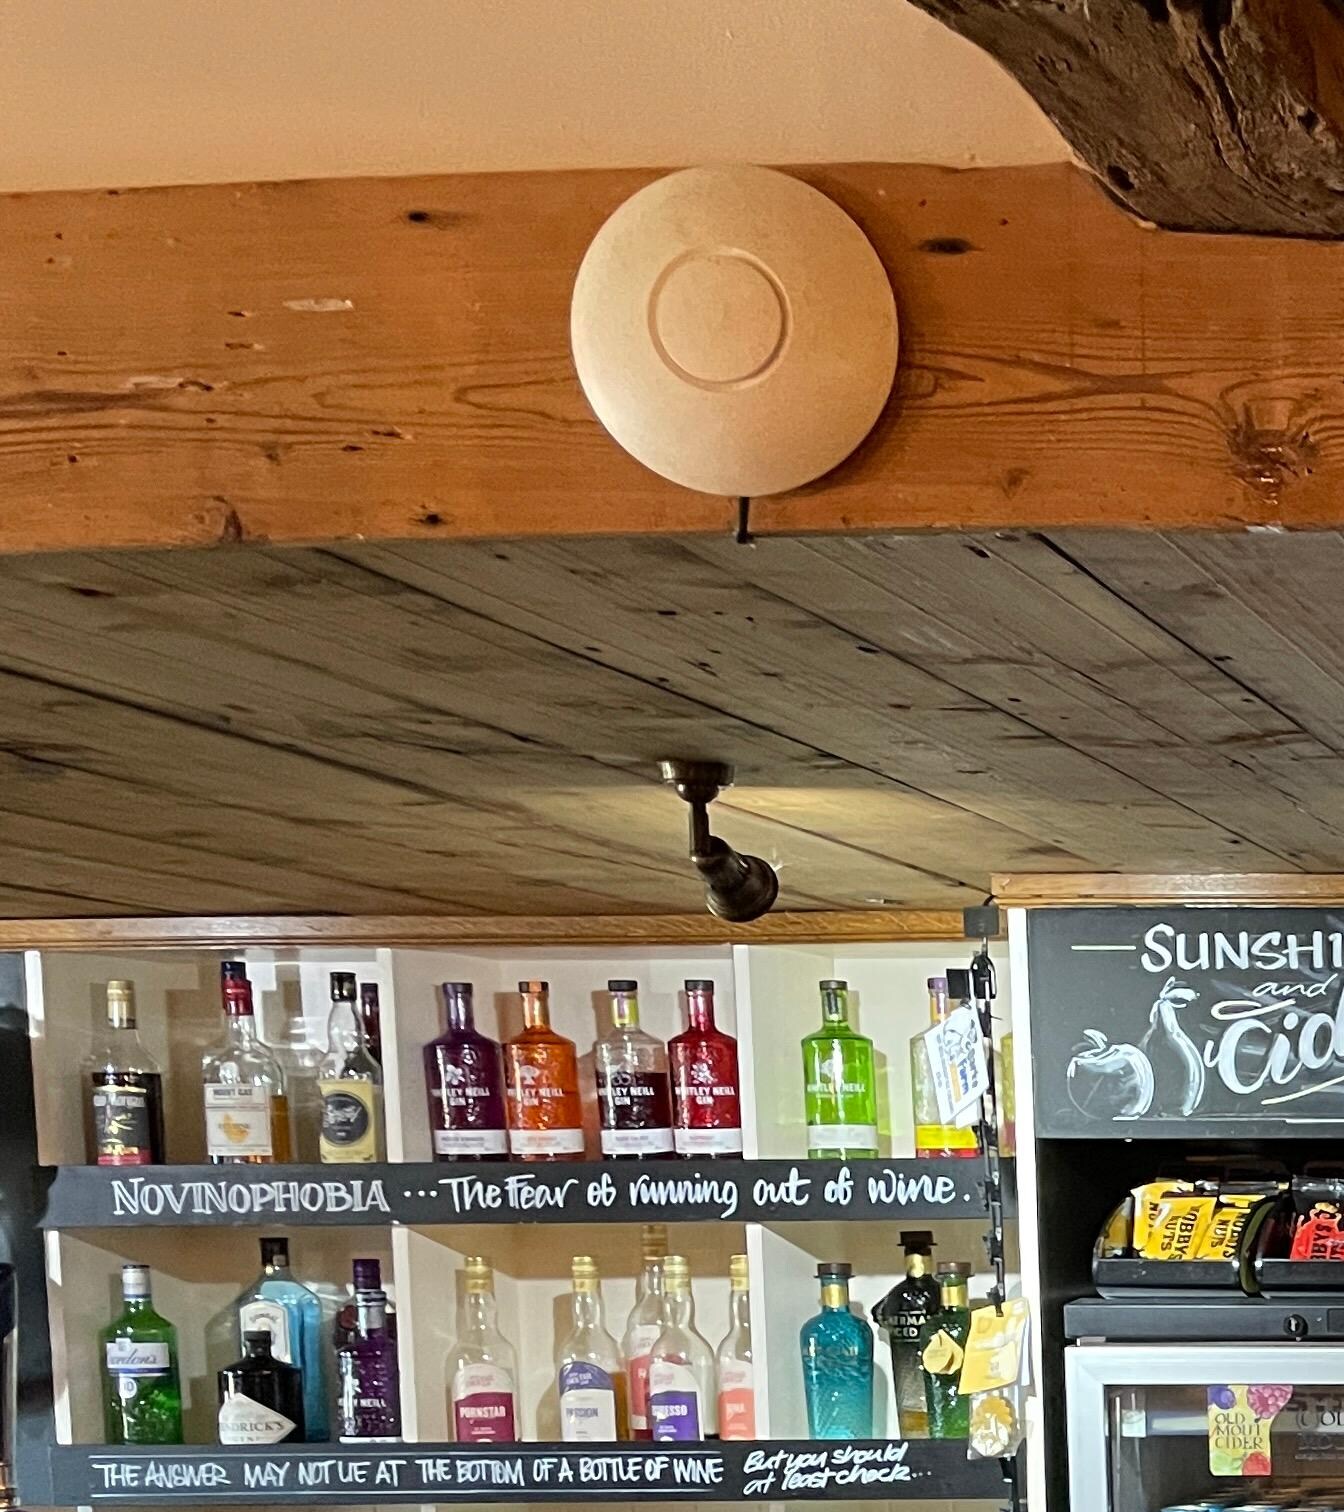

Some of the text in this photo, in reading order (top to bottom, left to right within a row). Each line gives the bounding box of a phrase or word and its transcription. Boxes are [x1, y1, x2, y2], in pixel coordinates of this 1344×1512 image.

[1252, 973, 1338, 998] and
[438, 1174, 502, 1213] The
[504, 1174, 579, 1209] Fear
[587, 1172, 616, 1207] of
[629, 1172, 738, 1219] running
[753, 1167, 811, 1206] out
[824, 1166, 854, 1207] of
[1214, 1413, 1246, 1425] OLD
[1213, 1436, 1264, 1450] CIDER
[92, 1463, 141, 1487] THE
[144, 1462, 232, 1488] ANSWER
[244, 1462, 290, 1487] MAY
[299, 1461, 331, 1486] NOT
[375, 1460, 407, 1485] AT
[415, 1459, 452, 1483] THE
[457, 1459, 525, 1486] BOTTOM
[533, 1458, 558, 1482] OF
[558, 1460, 574, 1483] A
[579, 1458, 641, 1483] BOTTLE
[644, 1456, 670, 1481] OF
[673, 1458, 724, 1484] WINE
[743, 1442, 908, 1480] But you should
[743, 1473, 776, 1496] at
